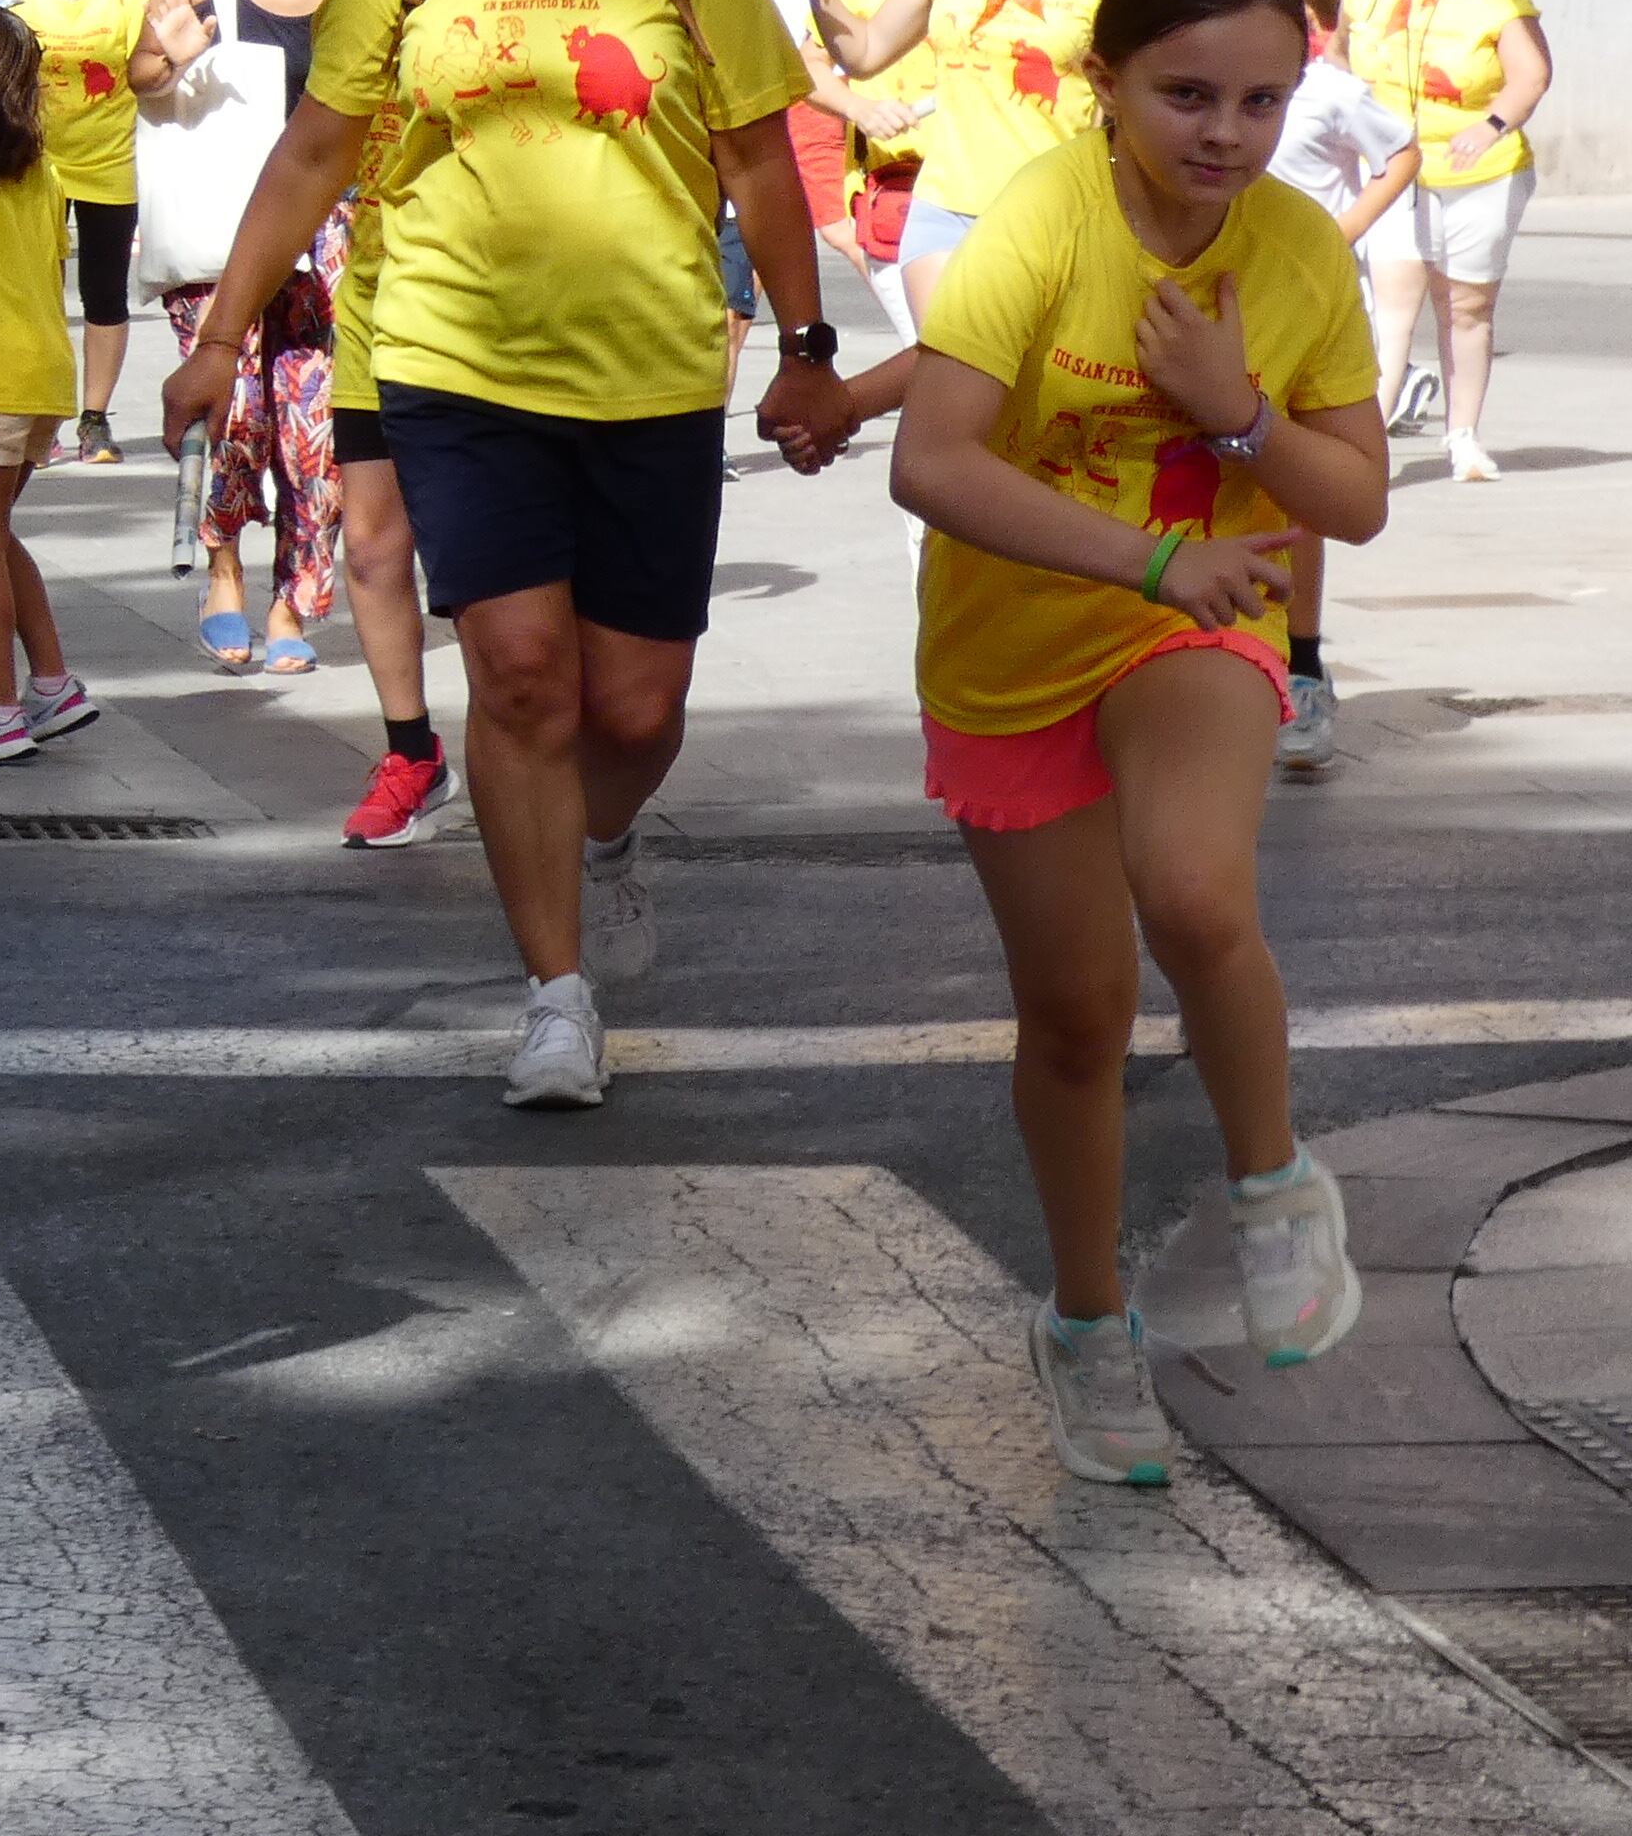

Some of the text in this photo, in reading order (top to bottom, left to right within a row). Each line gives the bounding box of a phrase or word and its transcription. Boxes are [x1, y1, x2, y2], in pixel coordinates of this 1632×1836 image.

[482, 0, 498, 12] EN
[1052, 347, 1155, 390] III SAN FERM
